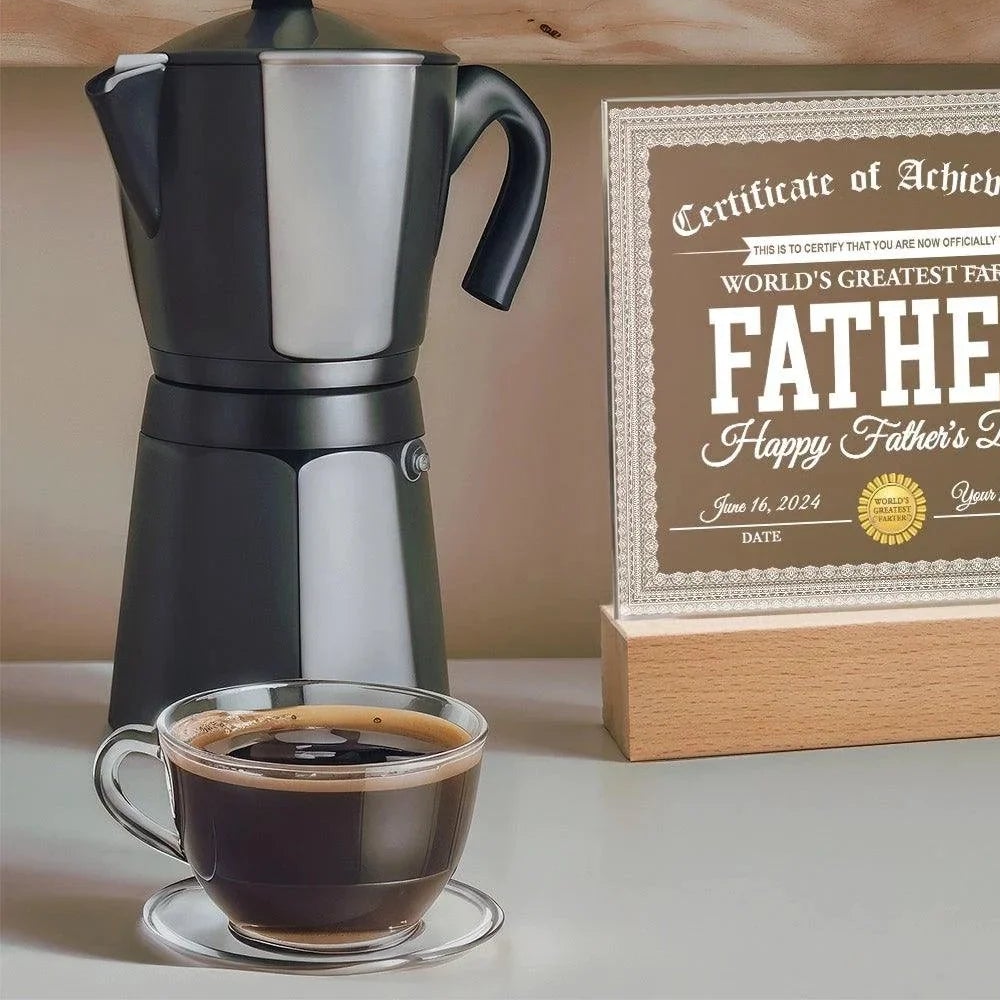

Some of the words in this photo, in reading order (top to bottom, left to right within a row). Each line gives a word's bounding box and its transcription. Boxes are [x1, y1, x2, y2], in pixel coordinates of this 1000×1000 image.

[672, 171, 835, 237] Certificate
[850, 161, 881, 193] of
[753, 244, 775, 256] THIS
[778, 244, 787, 255] IS
[789, 243, 803, 255] TO
[804, 241, 844, 255] CERTIFY
[846, 241, 871, 253] THAT
[872, 240, 894, 252] YOU
[895, 239, 916, 251] ARE
[917, 239, 942, 250] NOW
[943, 236, 997, 250] OFFICIALLY
[720, 270, 832, 294] WORLD'S
[837, 265, 957, 288] GREATEST
[701, 418, 831, 470] Happy
[840, 414, 969, 461] Father's
[699, 492, 747, 523] June
[751, 496, 774, 515] 16,
[776, 493, 821, 512] 2024
[873, 505, 912, 514] GREATEST
[874, 496, 909, 505] WORLD'S
[951, 480, 996, 512] Your
[741, 530, 782, 545] DATE
